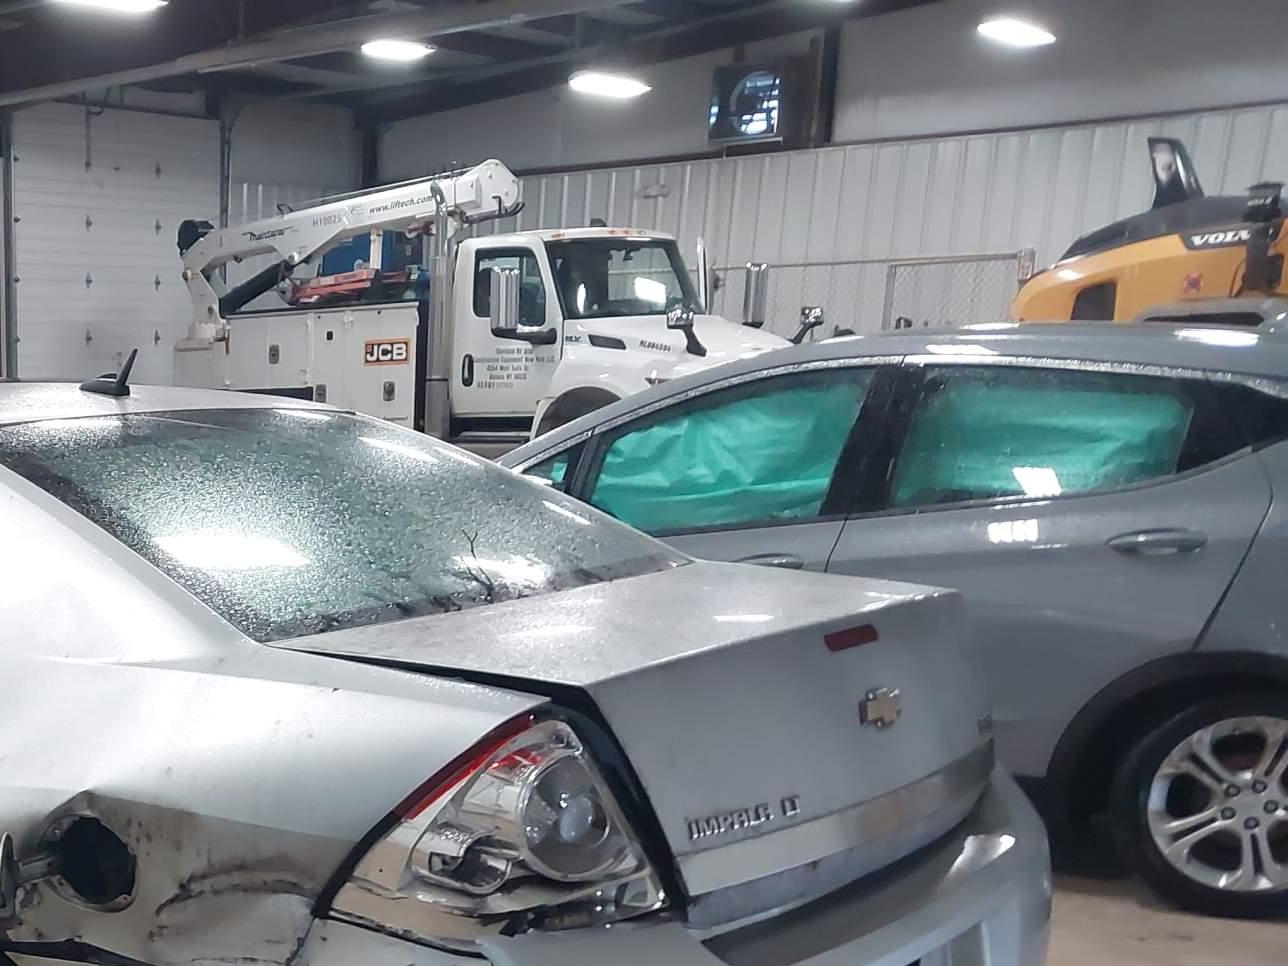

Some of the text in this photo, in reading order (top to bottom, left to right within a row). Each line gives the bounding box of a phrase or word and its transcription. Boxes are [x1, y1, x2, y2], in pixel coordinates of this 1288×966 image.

[369, 195, 433, 214] www.liftech.com
[366, 342, 407, 362] JCB
[688, 795, 801, 841] IMPALA LT
